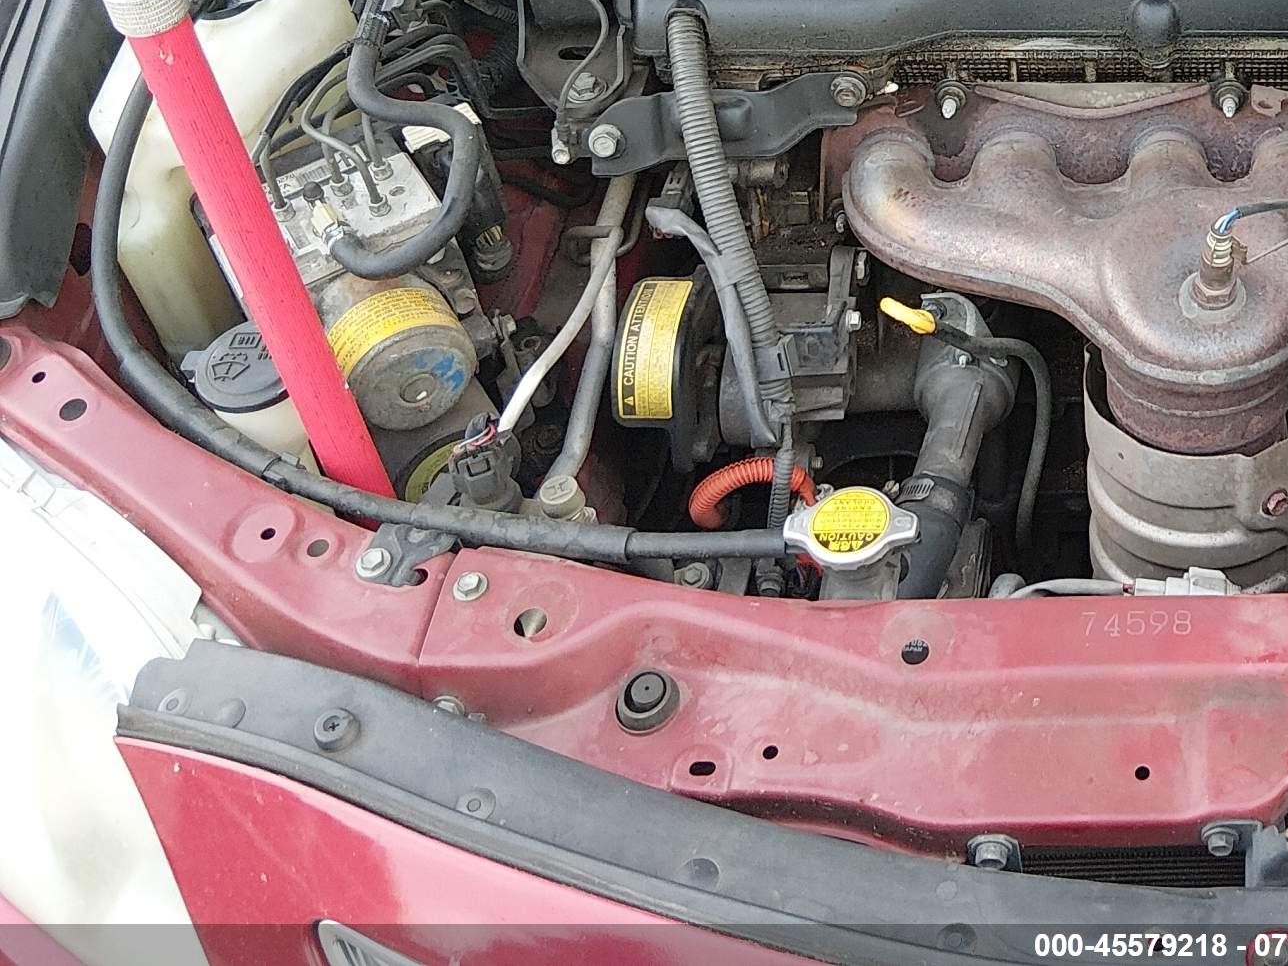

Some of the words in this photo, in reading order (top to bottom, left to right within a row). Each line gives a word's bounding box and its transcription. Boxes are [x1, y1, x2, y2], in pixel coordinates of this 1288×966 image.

[623, 336, 637, 386] CAUTION
[630, 287, 655, 333] ATTENTION
[819, 532, 875, 541] CAUTION
[1081, 610, 1192, 637] 74598
